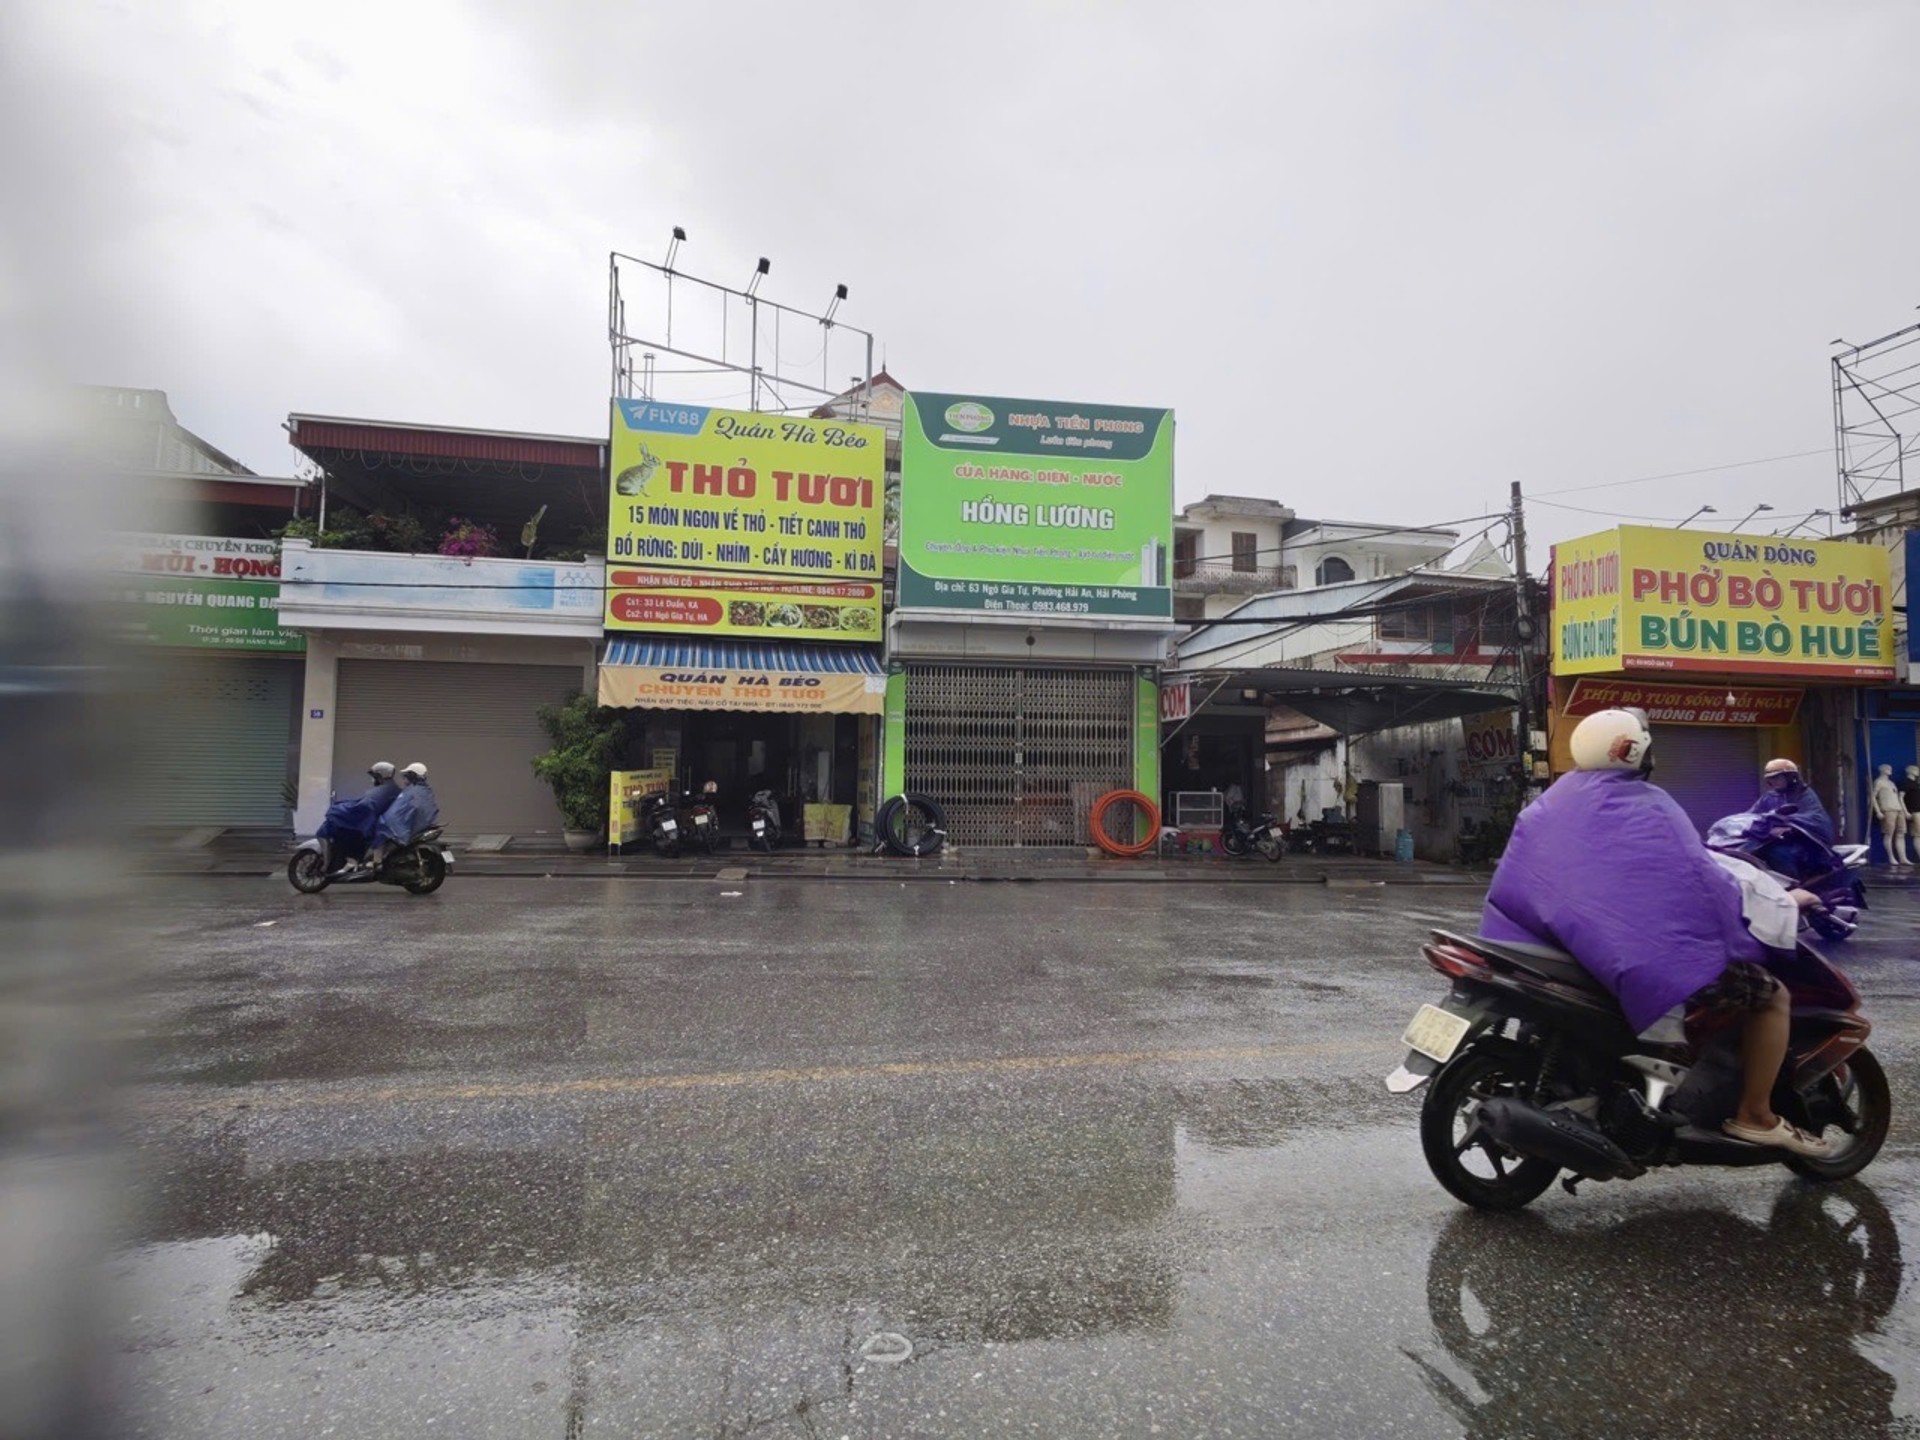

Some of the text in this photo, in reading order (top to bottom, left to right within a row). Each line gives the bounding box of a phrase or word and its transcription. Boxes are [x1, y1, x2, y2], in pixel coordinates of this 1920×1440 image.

[649, 408, 699, 426] FLY88
[1094, 419, 1144, 433] PHONG
[714, 416, 869, 448] Quán Hà Béo
[666, 457, 873, 508] THỎ TƯƠI
[629, 505, 644, 524] 15
[648, 503, 679, 526] MÓN
[683, 508, 719, 530] NGON
[743, 508, 766, 533] THỎ
[779, 511, 803, 536] TIẾT
[807, 518, 840, 538] CANH
[844, 515, 867, 540] THỎ
[1036, 504, 1115, 530] LƯƠNG
[184, 538, 243, 554] CHUYÊN
[637, 535, 677, 559] RỪNG:
[682, 538, 704, 561] DÚI
[717, 541, 750, 564] NHÍM
[791, 548, 833, 569] HƯƠNG
[844, 549, 857, 570] KÌ
[860, 550, 876, 572] ĐÀ
[1704, 539, 1817, 568] QUÁN ĐÔNG
[213, 557, 281, 579] HỌNG
[969, 583, 979, 593] 63
[1633, 564, 1885, 617] PHỞ BÒ TƯƠI
[207, 593, 255, 609] QUANG
[221, 627, 248, 636] gian
[1641, 609, 1885, 660] BÚN BÒ HUẾ
[660, 672, 821, 687] QUÁN HÀ BÉO
[1622, 688, 1642, 703] BÒ
[1648, 707, 1695, 721] MÓNG
[1729, 711, 1760, 723] 35K
